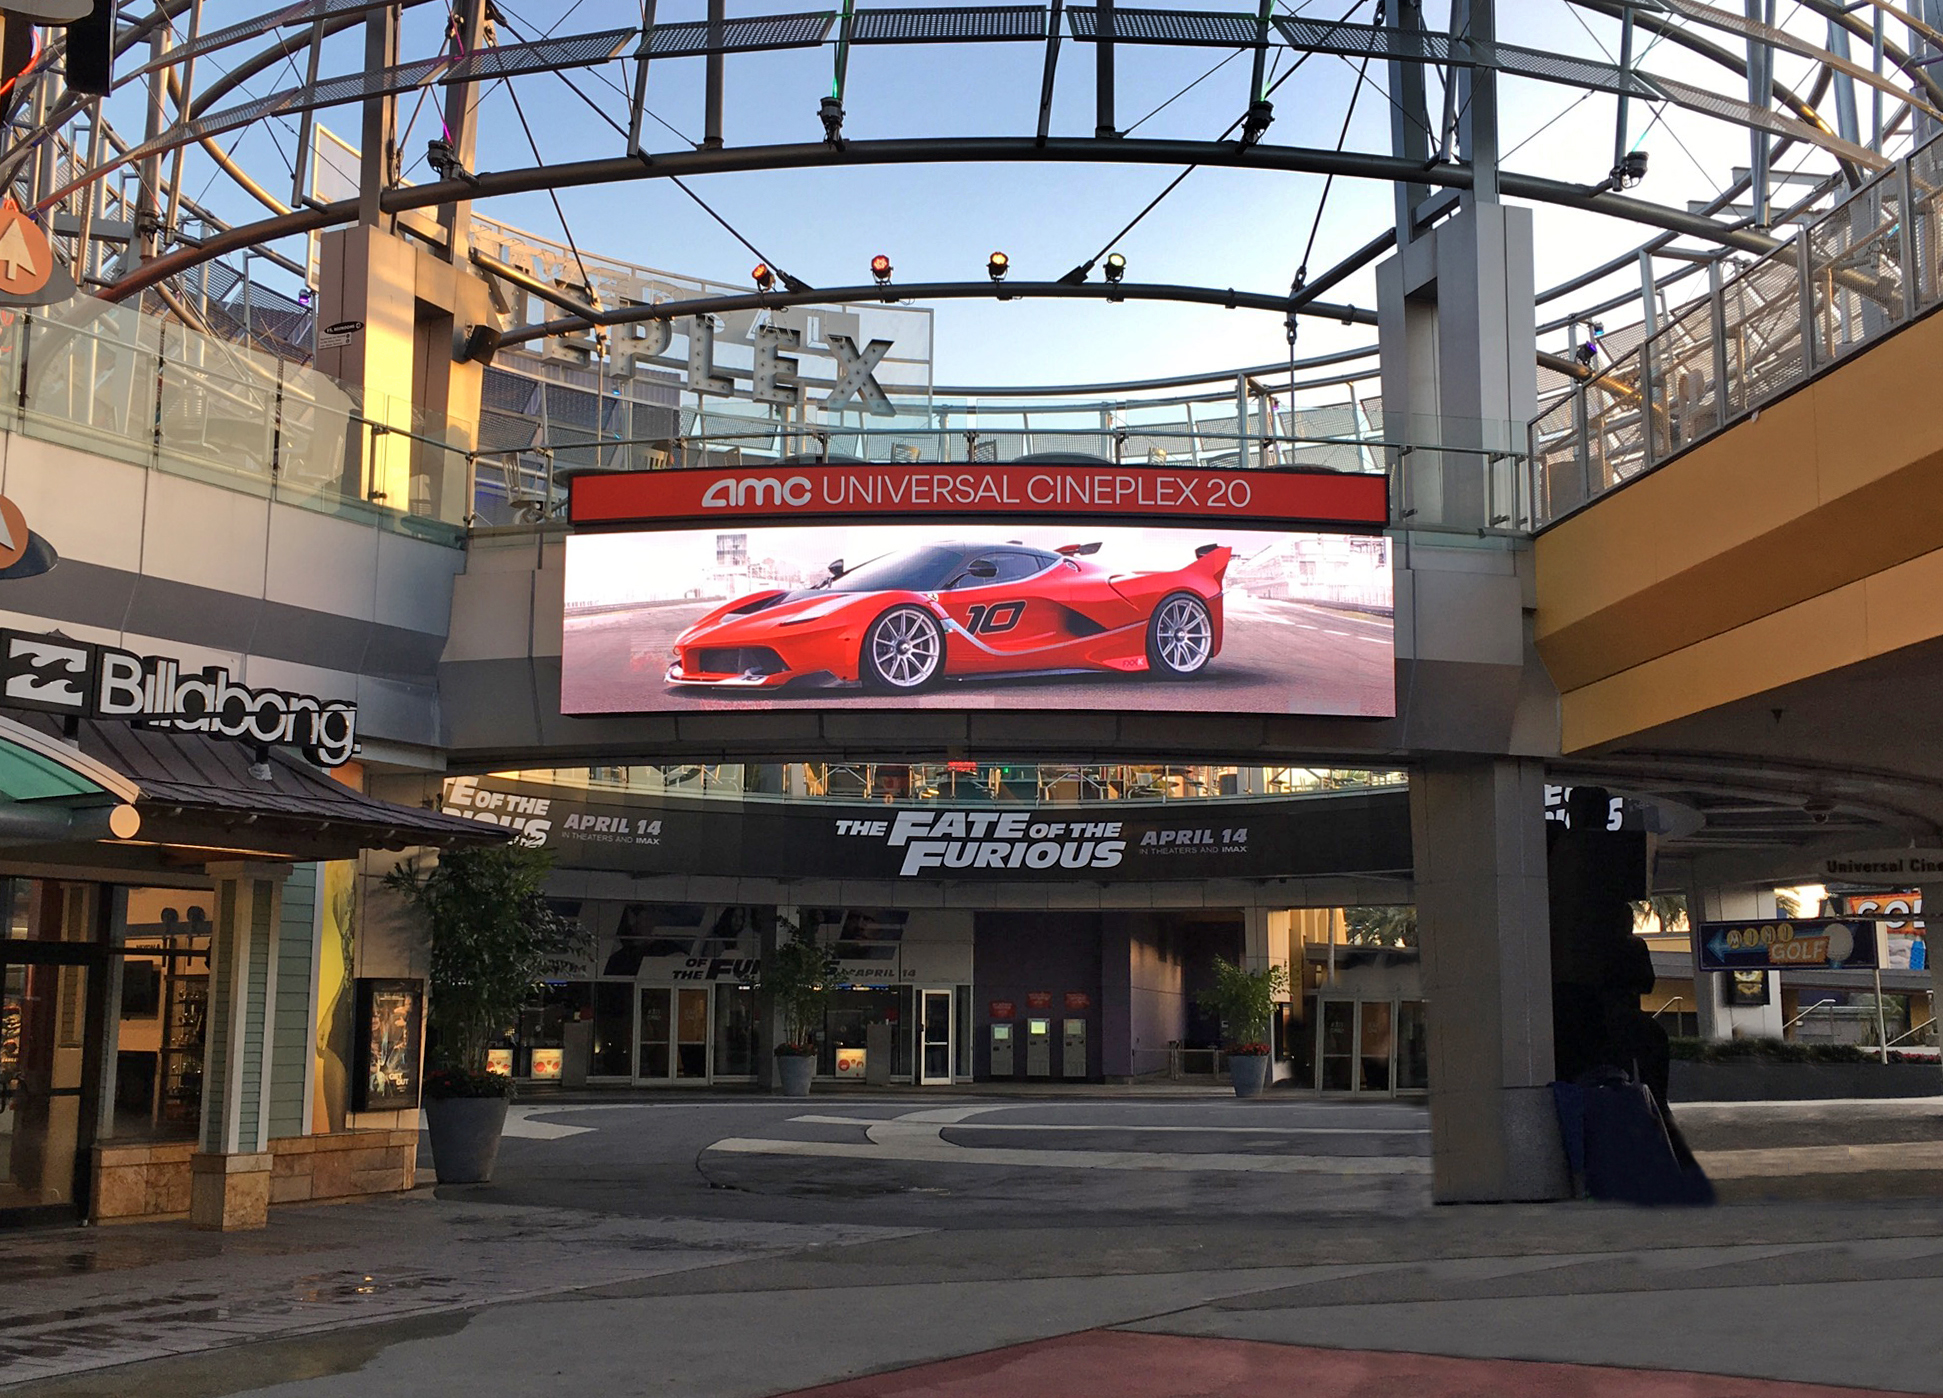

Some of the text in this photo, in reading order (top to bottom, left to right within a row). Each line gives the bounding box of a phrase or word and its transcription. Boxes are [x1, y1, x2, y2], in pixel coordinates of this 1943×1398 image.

[822, 474, 1021, 505] UNIVERSAL
[1026, 474, 1200, 507] CINEPLEX
[1206, 478, 1252, 508] 20
[965, 600, 1027, 636] 10
[475, 790, 505, 809] OF
[506, 794, 551, 816] THE
[563, 813, 631, 834] APRIL
[636, 819, 663, 836] 14
[835, 811, 1123, 846] THE FATE OF THE
[561, 831, 661, 846] IN THEATERS AND IMAX
[1140, 828, 1249, 846] APRIL 14
[899, 841, 1127, 876] FURIOUS
[1151, 846, 1198, 855] THEATERS
[1221, 845, 1248, 853] IMAX
[1827, 860, 1903, 873] Universal
[1728, 924, 1792, 947] MINI
[1771, 941, 1827, 960] GOLF
[672, 970, 704, 980] THE
